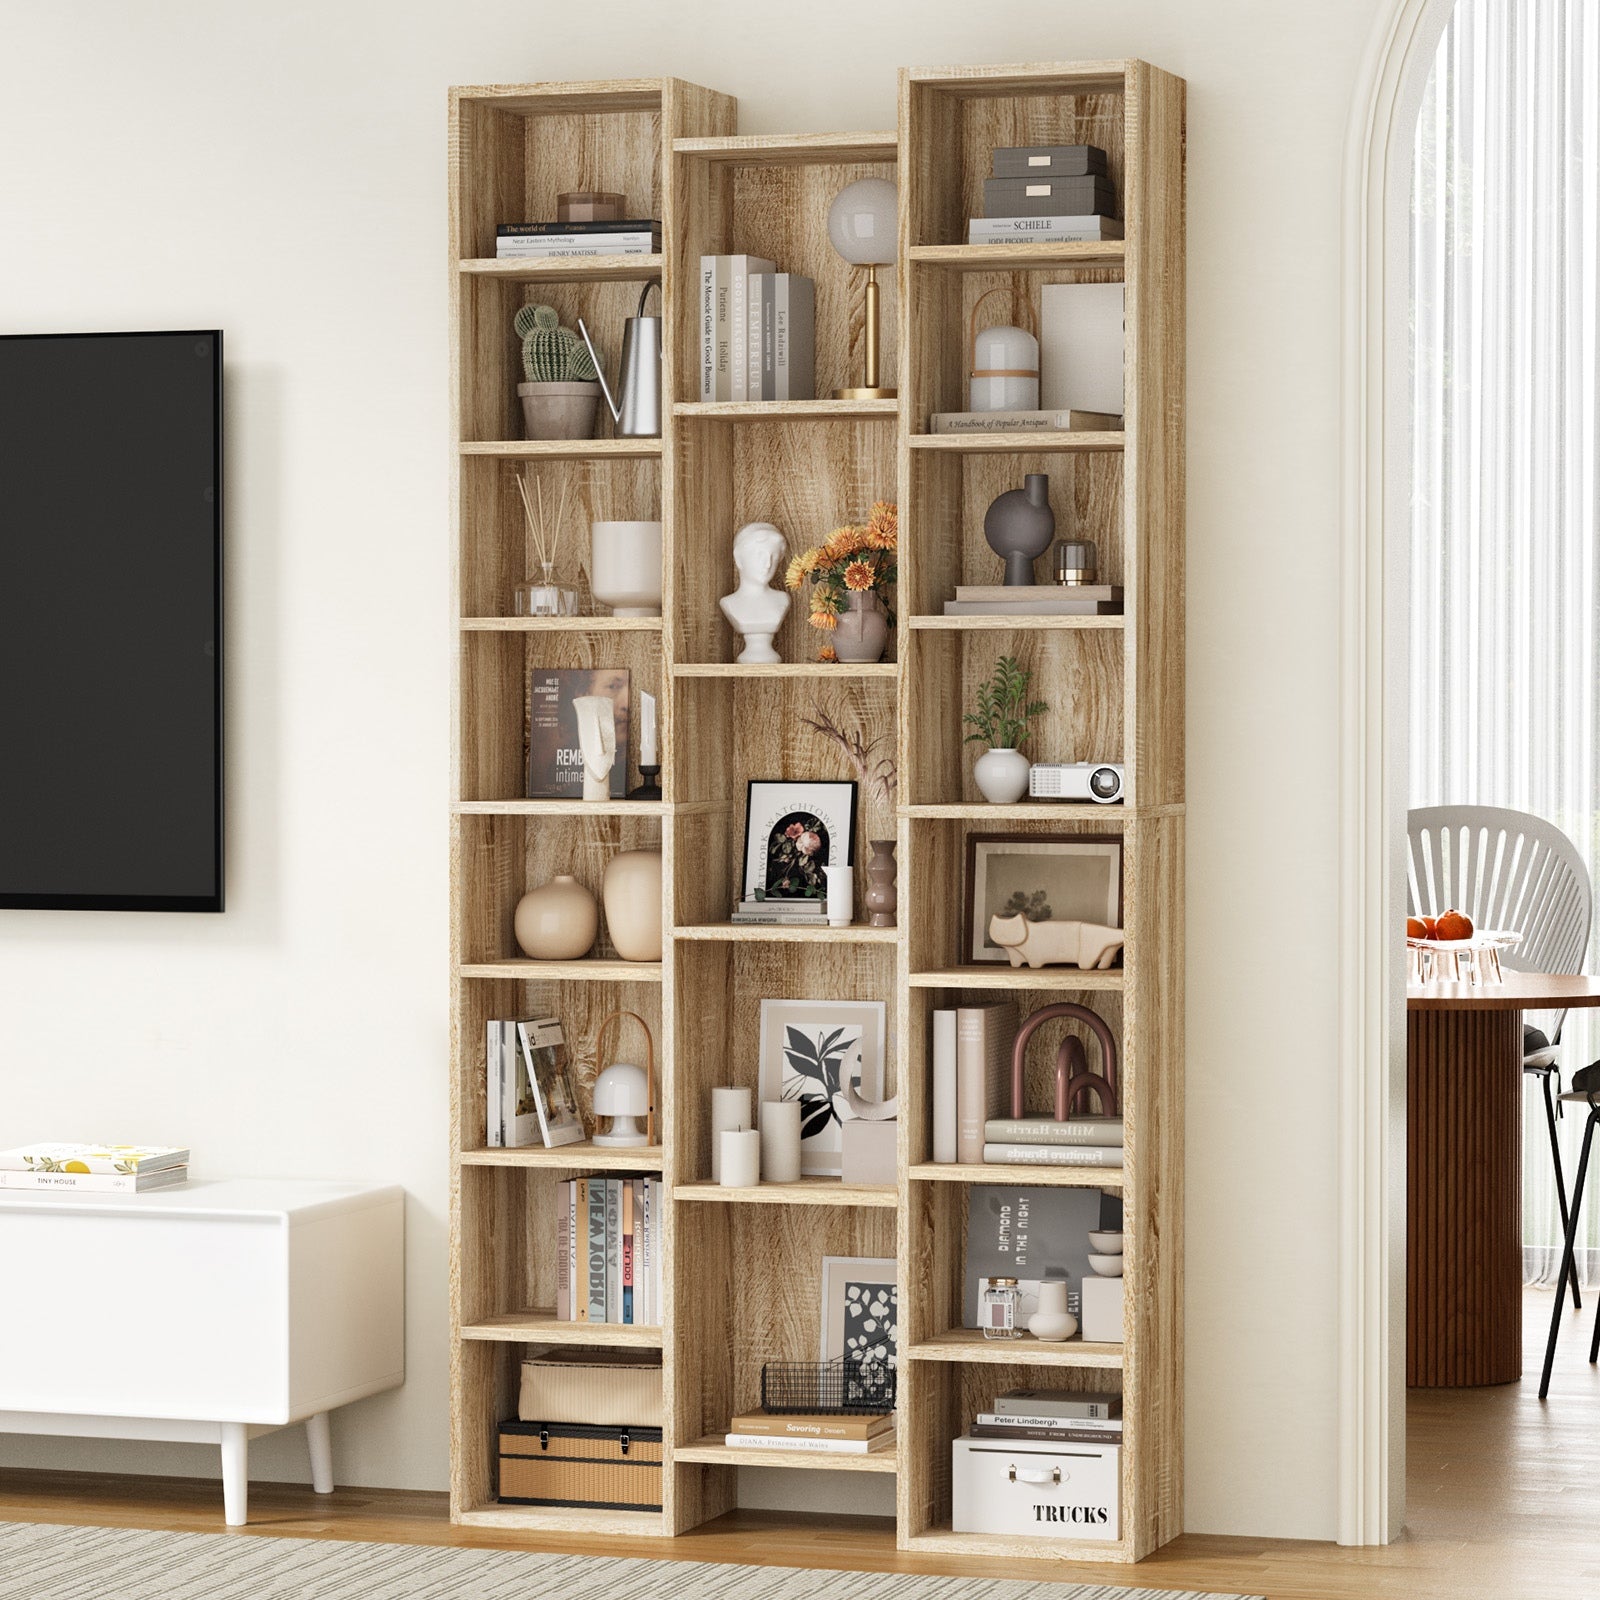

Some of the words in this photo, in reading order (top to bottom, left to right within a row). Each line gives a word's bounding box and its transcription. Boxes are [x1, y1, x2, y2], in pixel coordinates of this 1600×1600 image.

[506, 225, 518, 233] The
[539, 224, 546, 232] of
[1014, 220, 1052, 230] SCHIELE
[547, 236, 576, 244] Mythology
[1005, 236, 1034, 244] PICOULT
[704, 270, 712, 284] The
[704, 286, 712, 314] Monocle
[720, 287, 728, 322] Purienne
[704, 316, 712, 336] Guide
[778, 311, 786, 325] Lee
[704, 346, 712, 364] Good
[778, 328, 786, 366] Radziwill
[718, 341, 728, 373] Holiday
[704, 366, 712, 394] Business
[954, 419, 986, 428] Handbook
[986, 419, 994, 430] of
[995, 419, 1020, 430] Popular
[1020, 418, 1048, 428] Antiques
[758, 834, 769, 889] RTWORK
[766, 802, 838, 840] WATCHTOWER
[54, 1178, 76, 1186] HOUSE
[1017, 1197, 1030, 1228] NIGHT
[998, 1206, 1011, 1252] DIAMOND
[1016, 1234, 1028, 1252] THE
[1016, 1256, 1026, 1265] IN
[786, 1424, 821, 1435] Savoring
[994, 1416, 1016, 1424] Peter
[1018, 1418, 1058, 1427] Lindbergh
[808, 1440, 828, 1448] Wales
[1033, 1504, 1108, 1524] TRUCKS
